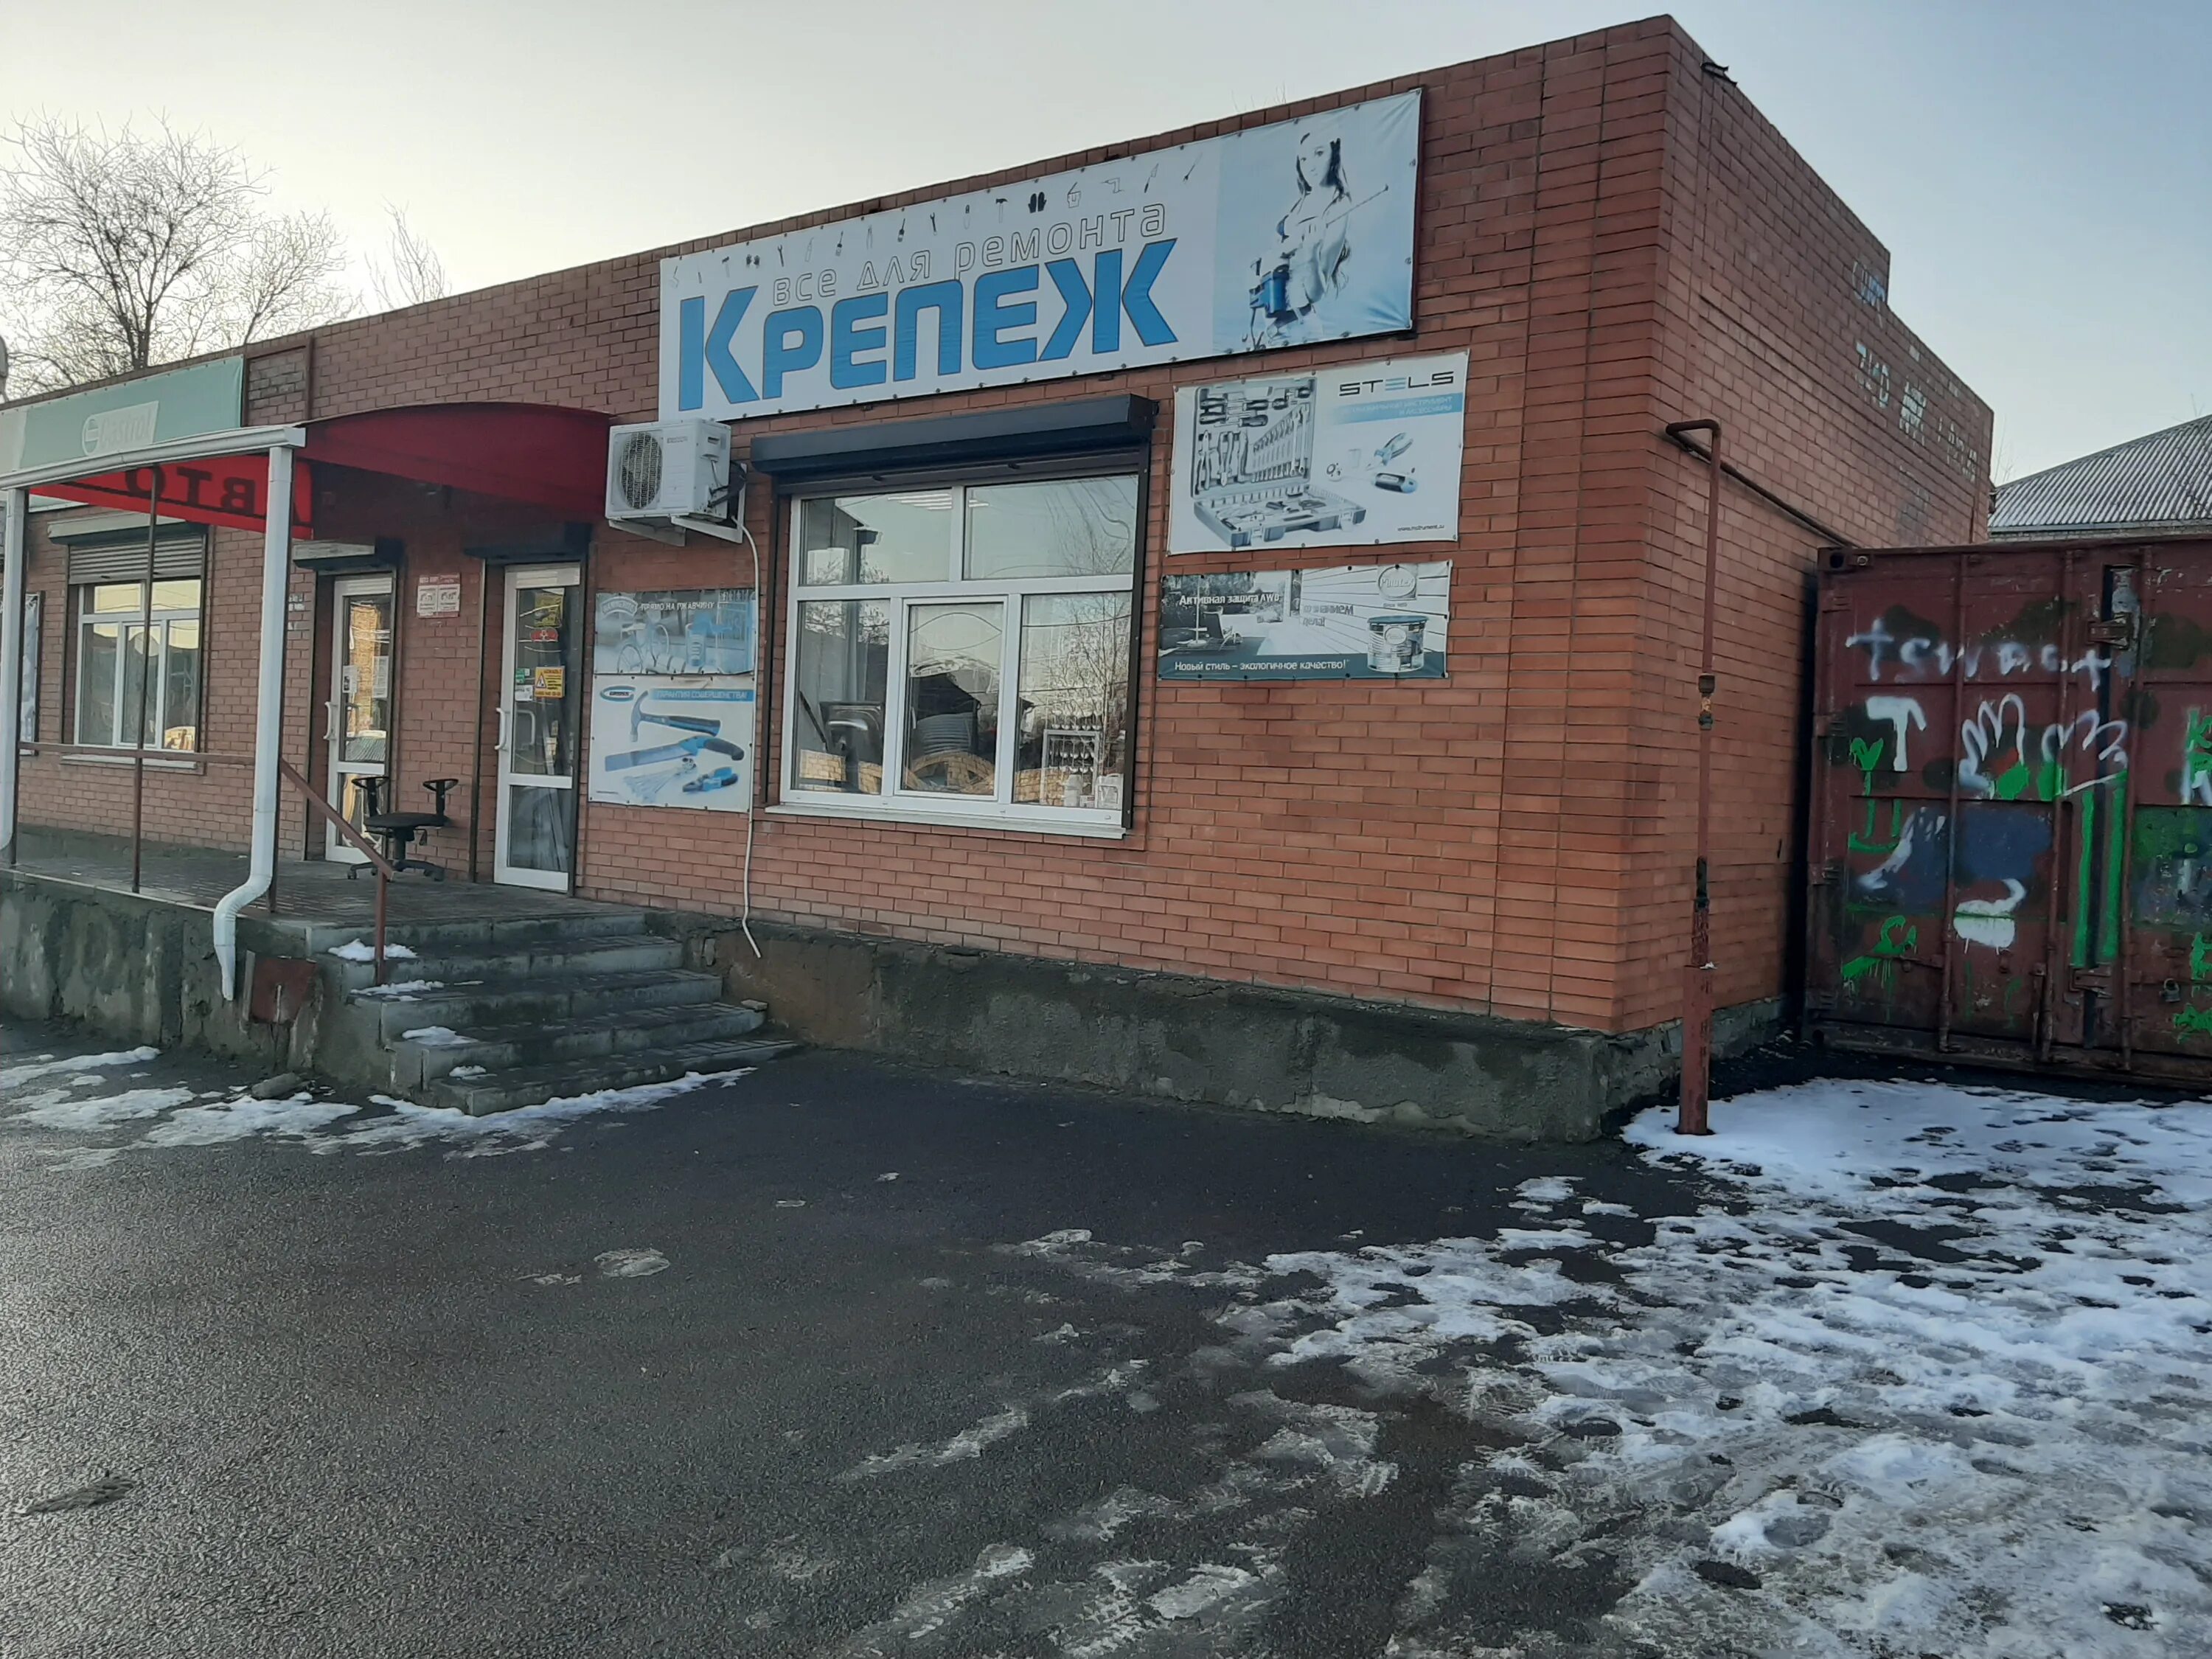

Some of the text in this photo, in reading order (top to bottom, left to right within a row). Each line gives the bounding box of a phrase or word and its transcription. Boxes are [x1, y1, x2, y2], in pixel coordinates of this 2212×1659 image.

[773, 202, 1166, 307] все для ремонта
[678, 237, 1178, 411] КРЕПЕЖ
[1339, 371, 1454, 396] STELS
[1179, 594, 1225, 605] Активная
[1227, 594, 1259, 604] защита
[1174, 661, 1203, 671] Новый
[1205, 662, 1231, 671] стиль
[1239, 661, 1298, 671] экологичное
